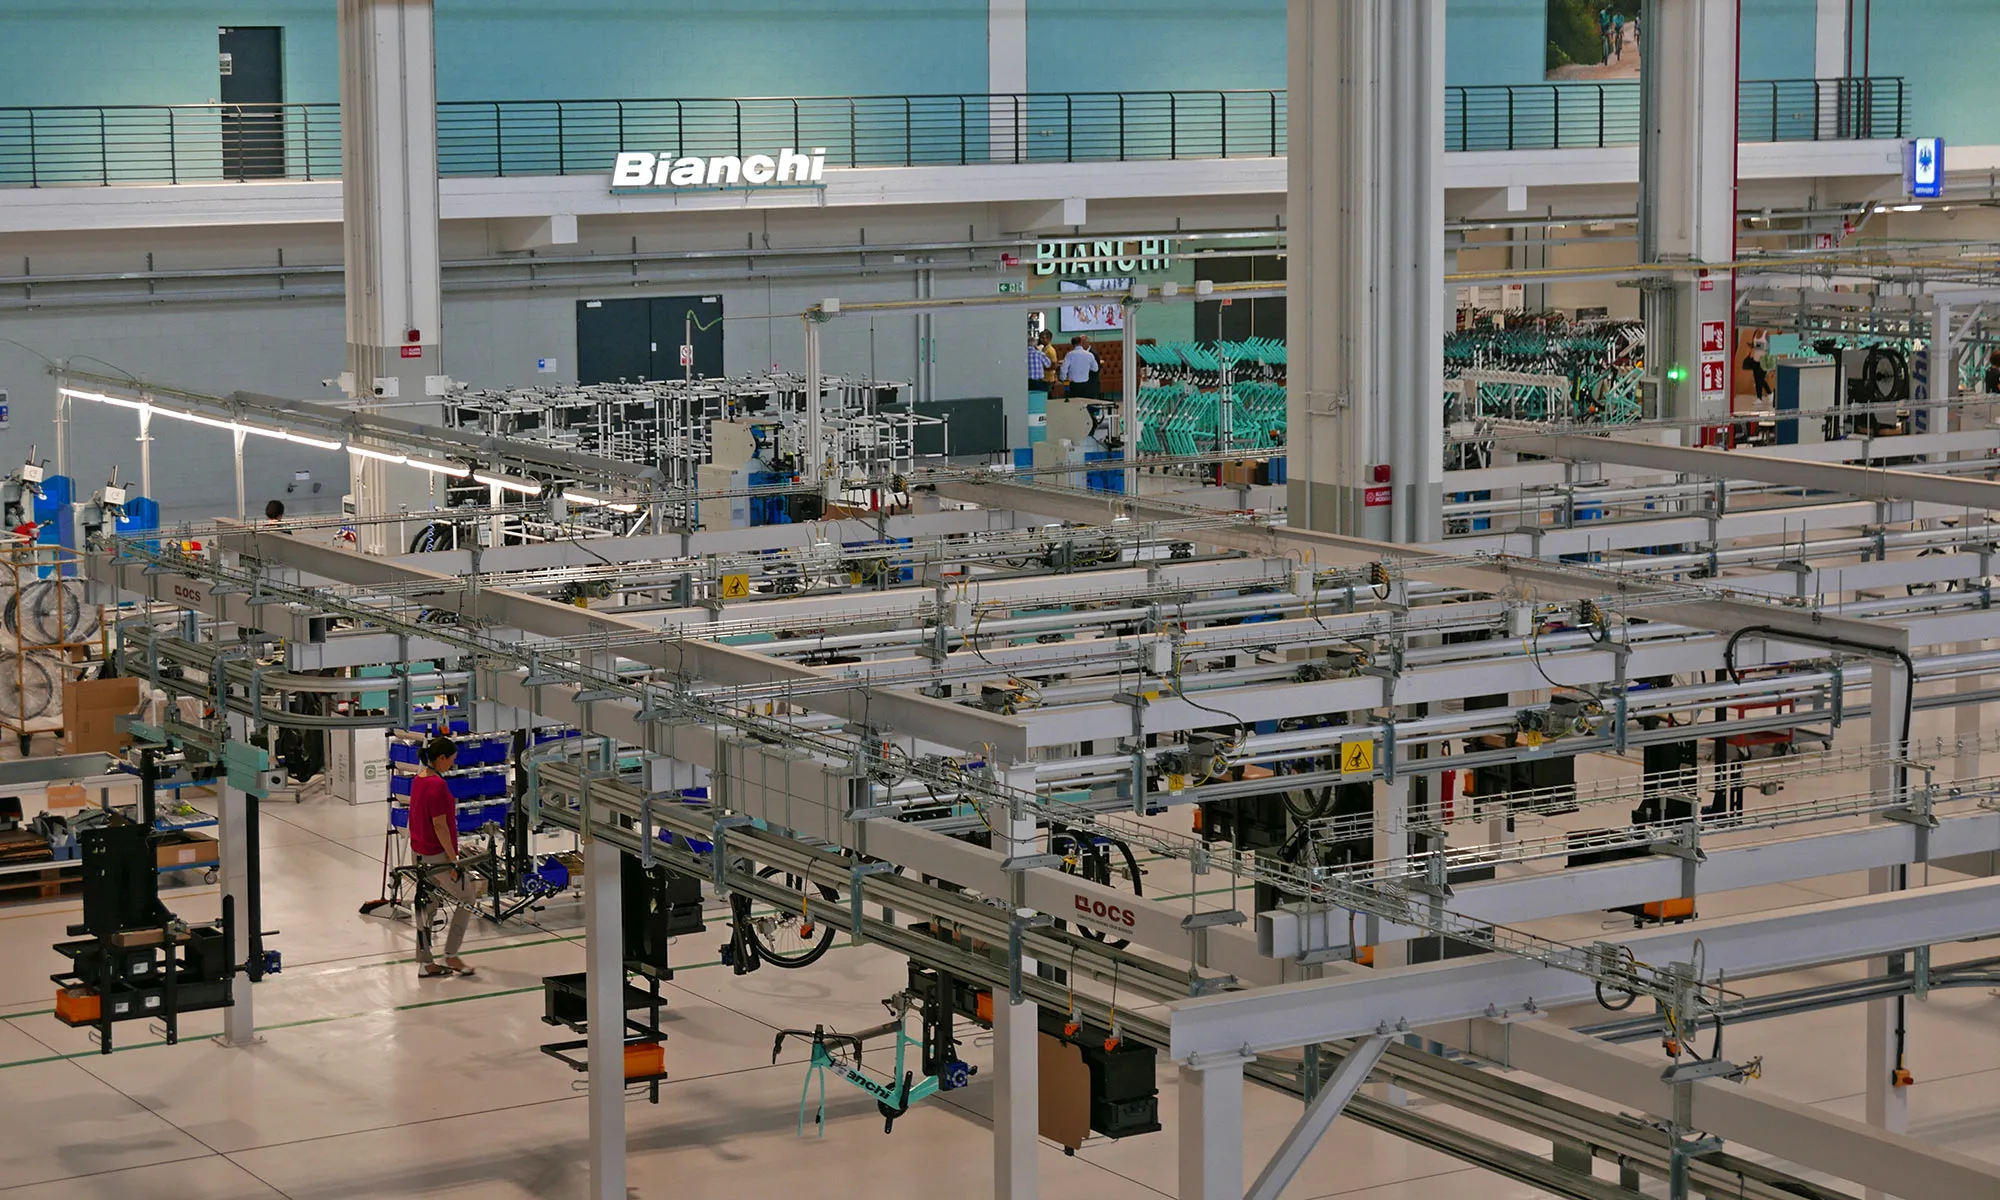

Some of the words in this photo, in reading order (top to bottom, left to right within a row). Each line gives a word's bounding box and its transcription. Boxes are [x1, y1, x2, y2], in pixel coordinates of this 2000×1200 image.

[612, 147, 827, 187] Bianchi
[1036, 239, 1170, 276] BIANCHI
[846, 1070, 892, 1100] anchi
